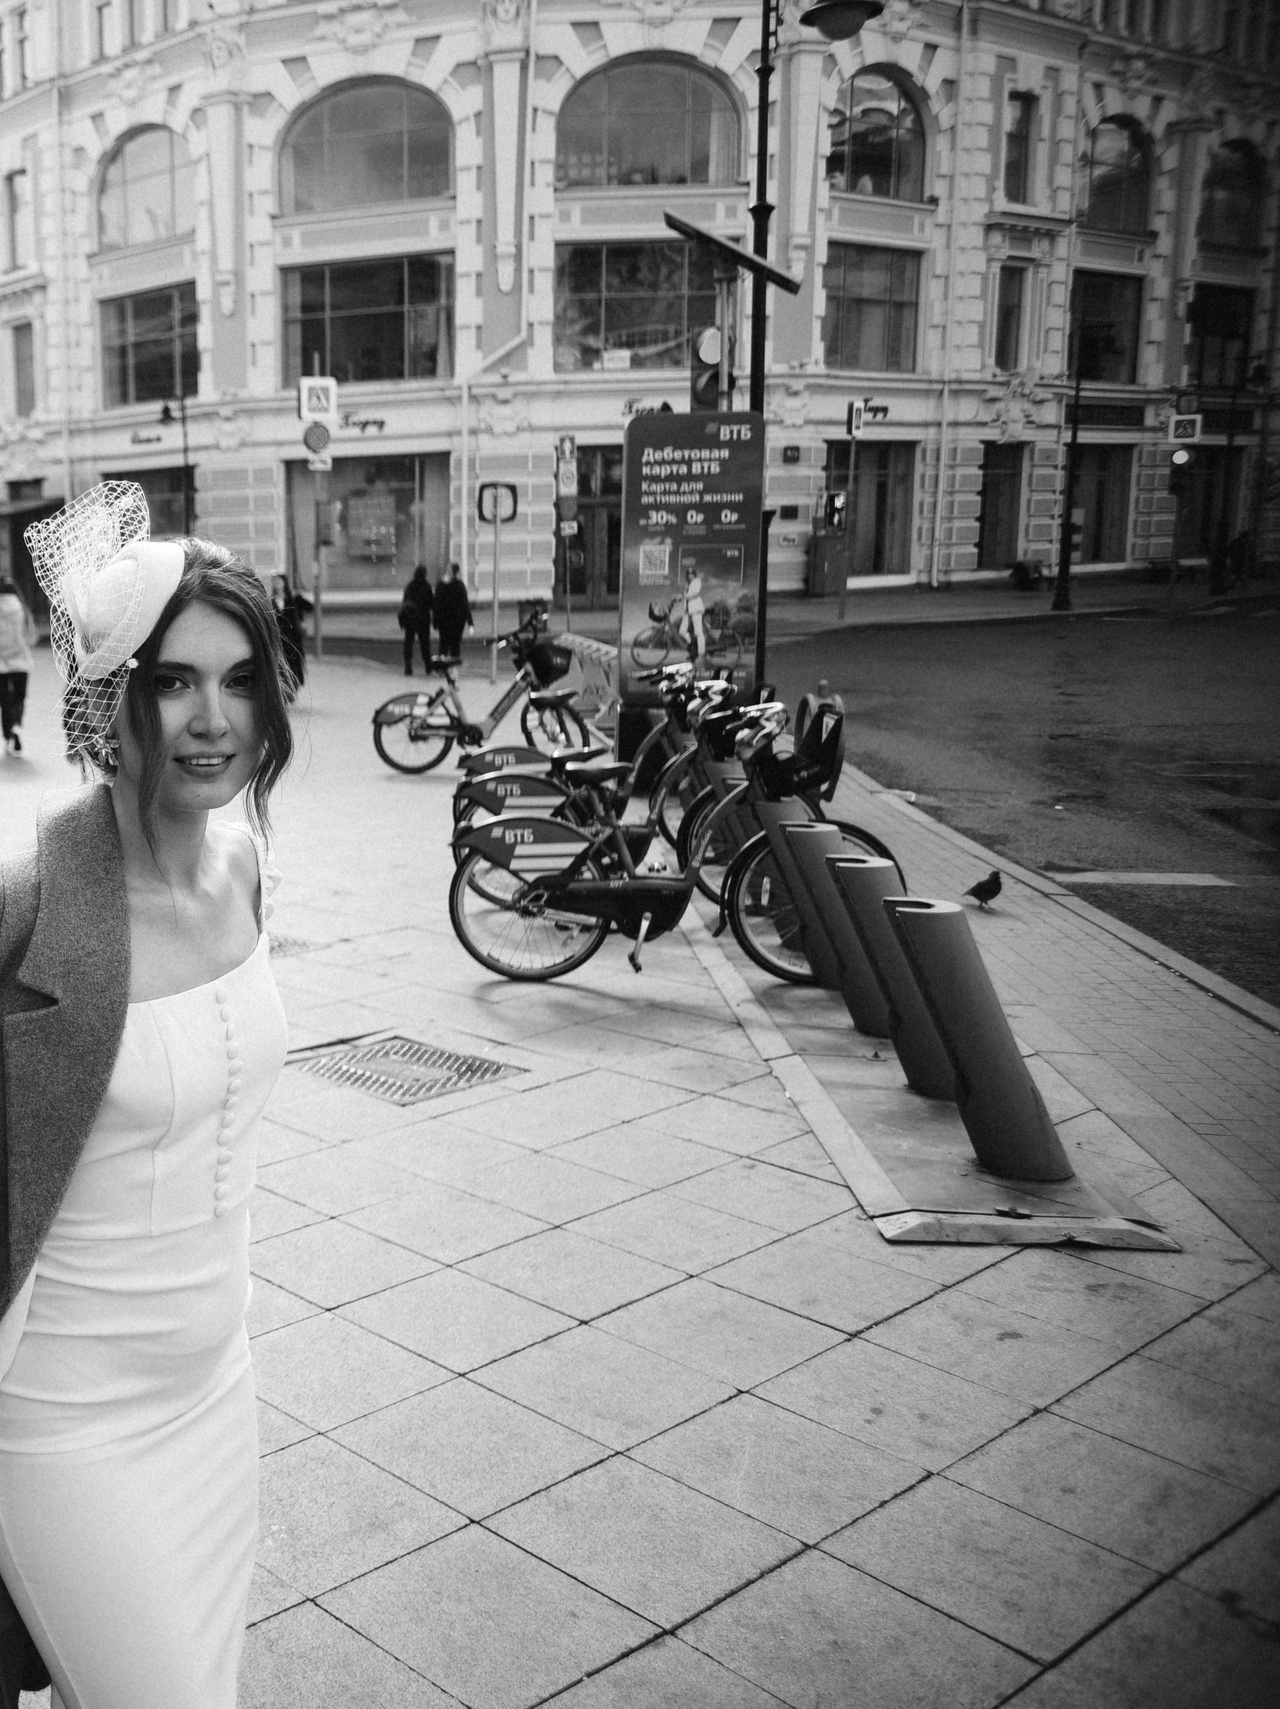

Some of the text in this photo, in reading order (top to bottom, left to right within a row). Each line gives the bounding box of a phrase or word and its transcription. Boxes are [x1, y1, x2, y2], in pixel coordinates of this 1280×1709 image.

[720, 424, 752, 441] ВТБ
[641, 446, 730, 463] Дебетовая
[642, 461, 720, 479] карта ВТБ
[641, 480, 704, 495] Карта для
[641, 492, 744, 505] активной жизни
[494, 753, 516, 767] ВТБ
[497, 783, 521, 797] ВТБ
[505, 828, 534, 844] ВТБ
